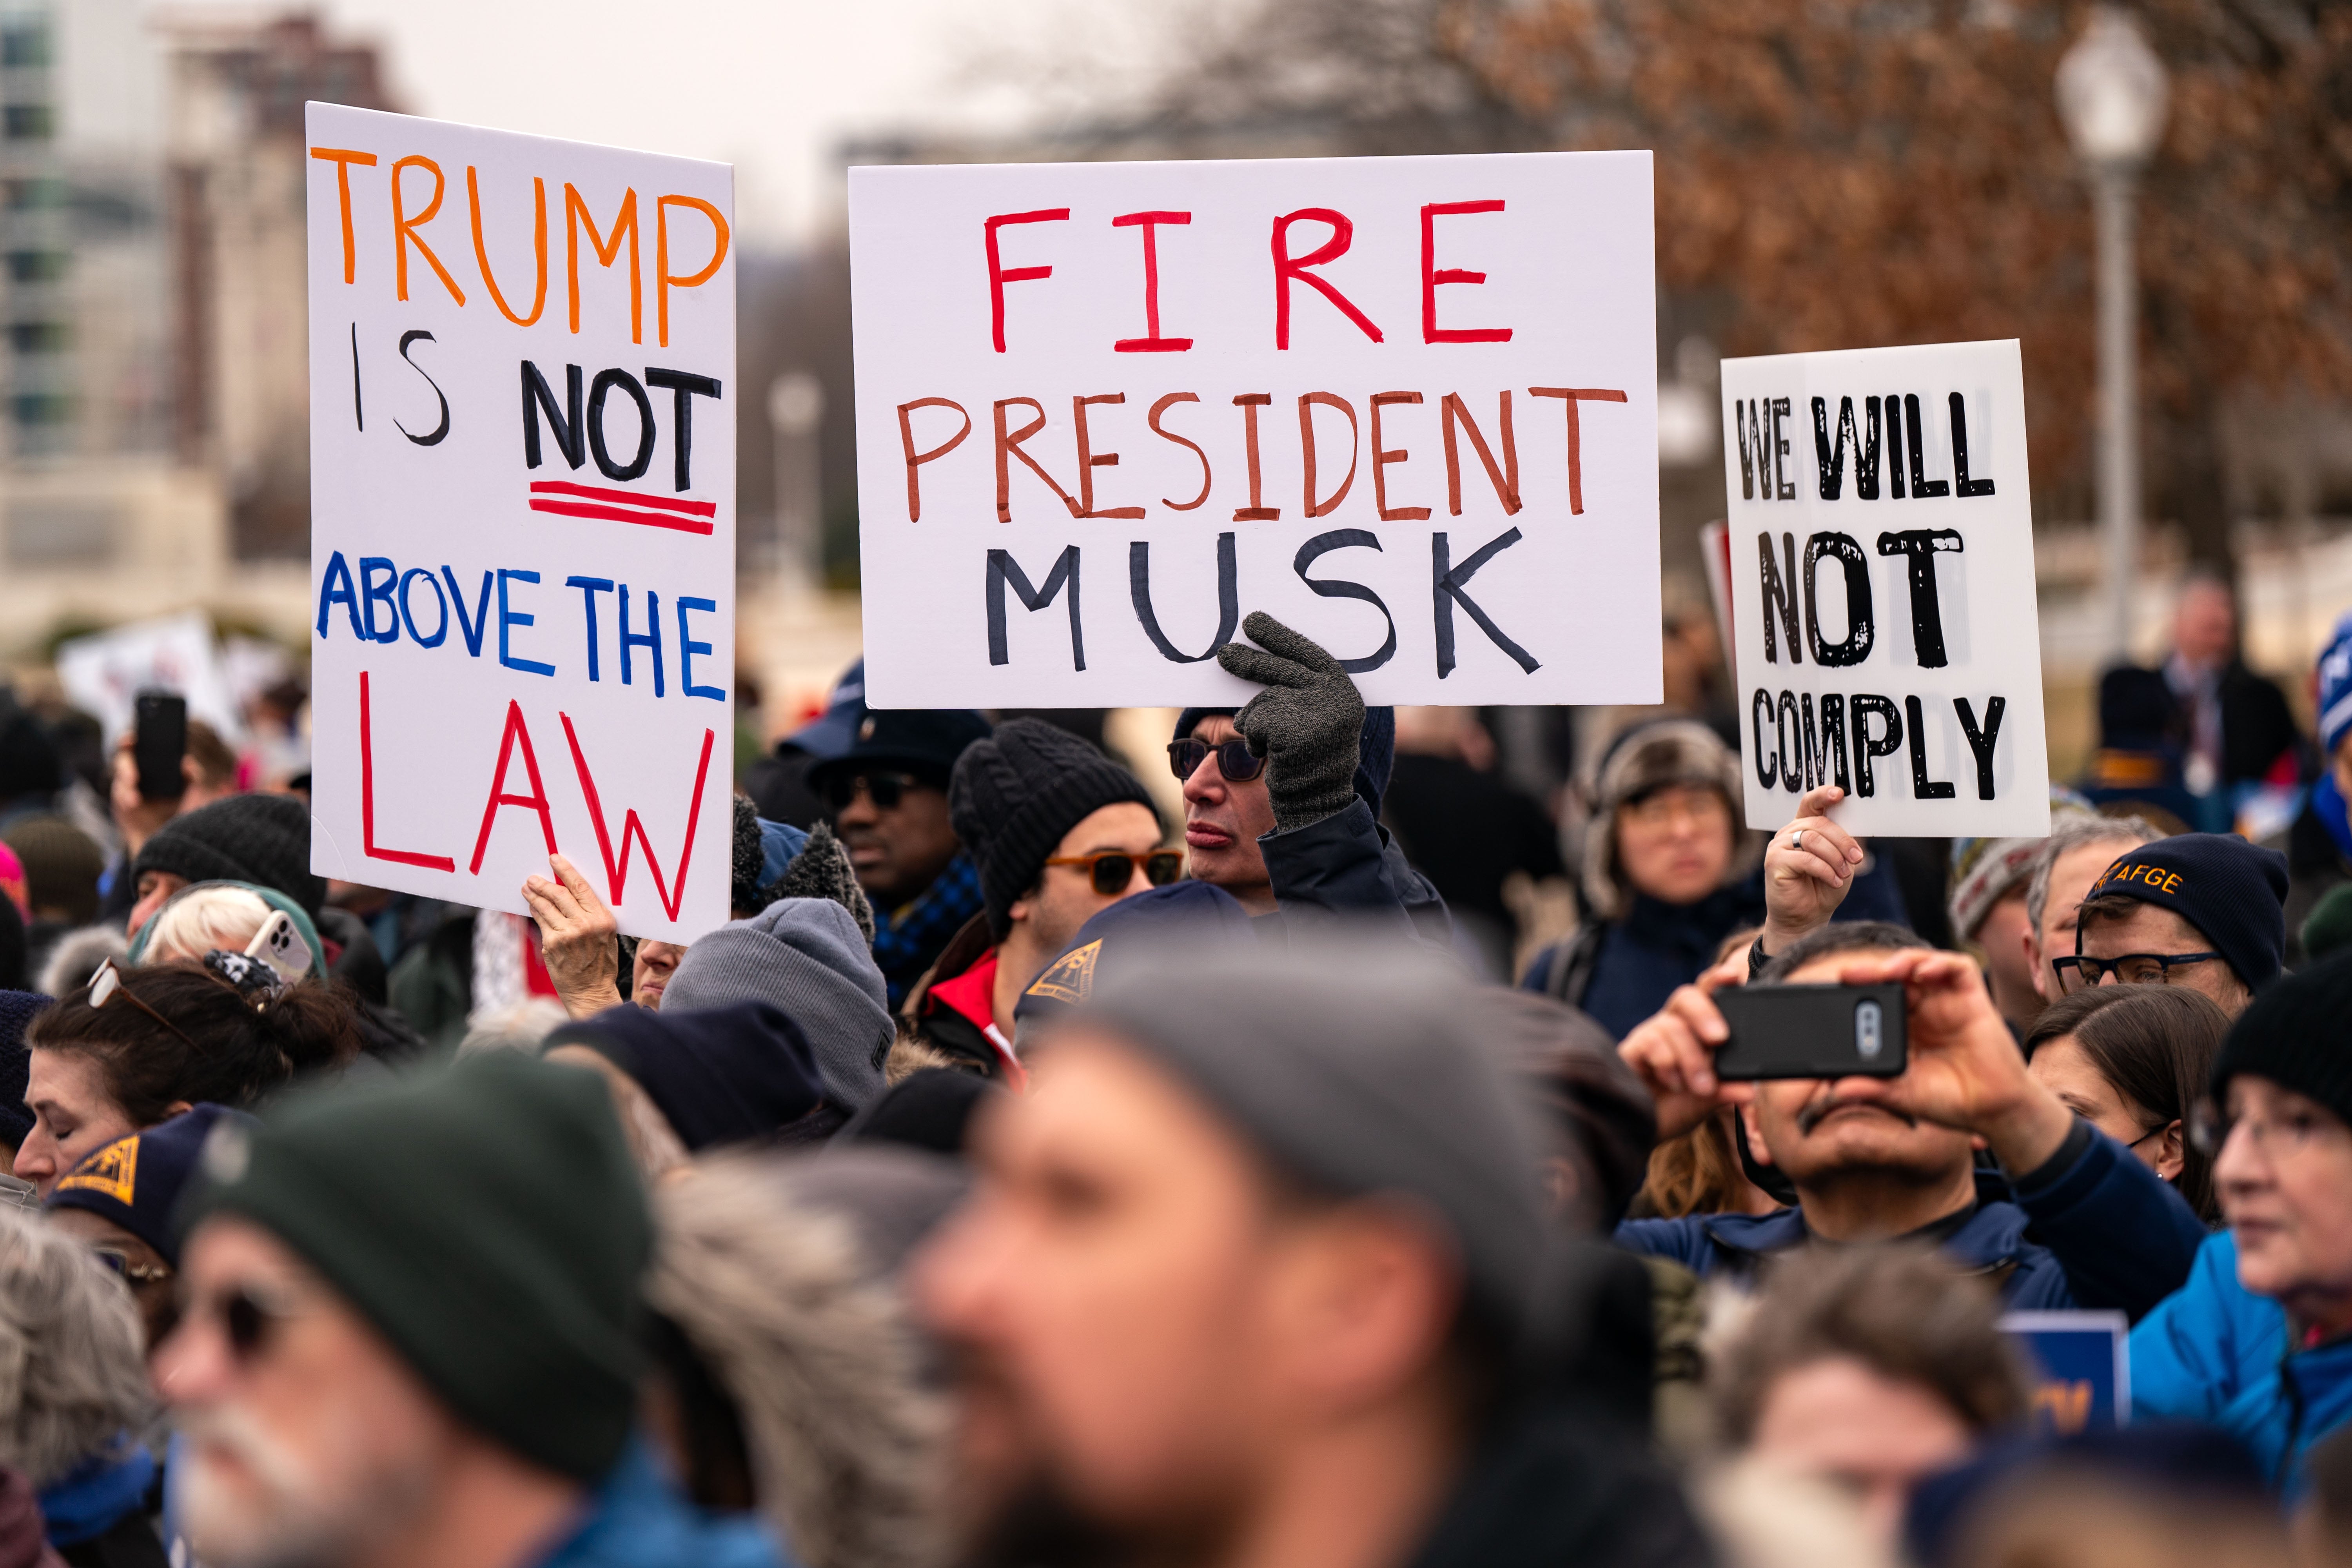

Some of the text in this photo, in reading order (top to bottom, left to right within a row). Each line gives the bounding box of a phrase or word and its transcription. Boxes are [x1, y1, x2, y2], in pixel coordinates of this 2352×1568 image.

[310, 147, 730, 347] TRUMP
[984, 200, 1513, 353] FIRE
[352, 321, 722, 492] IS NOT
[897, 387, 1628, 523] PRESIDENT
[1736, 392, 1996, 501] WE WILL
[316, 551, 726, 702] ABOVE THE
[986, 526, 1544, 679] MUSK
[1758, 528, 1964, 669] NOT
[359, 671, 714, 922] LAW
[1753, 688, 2006, 800] COMPLY
[2113, 864, 2184, 895] AFGE
